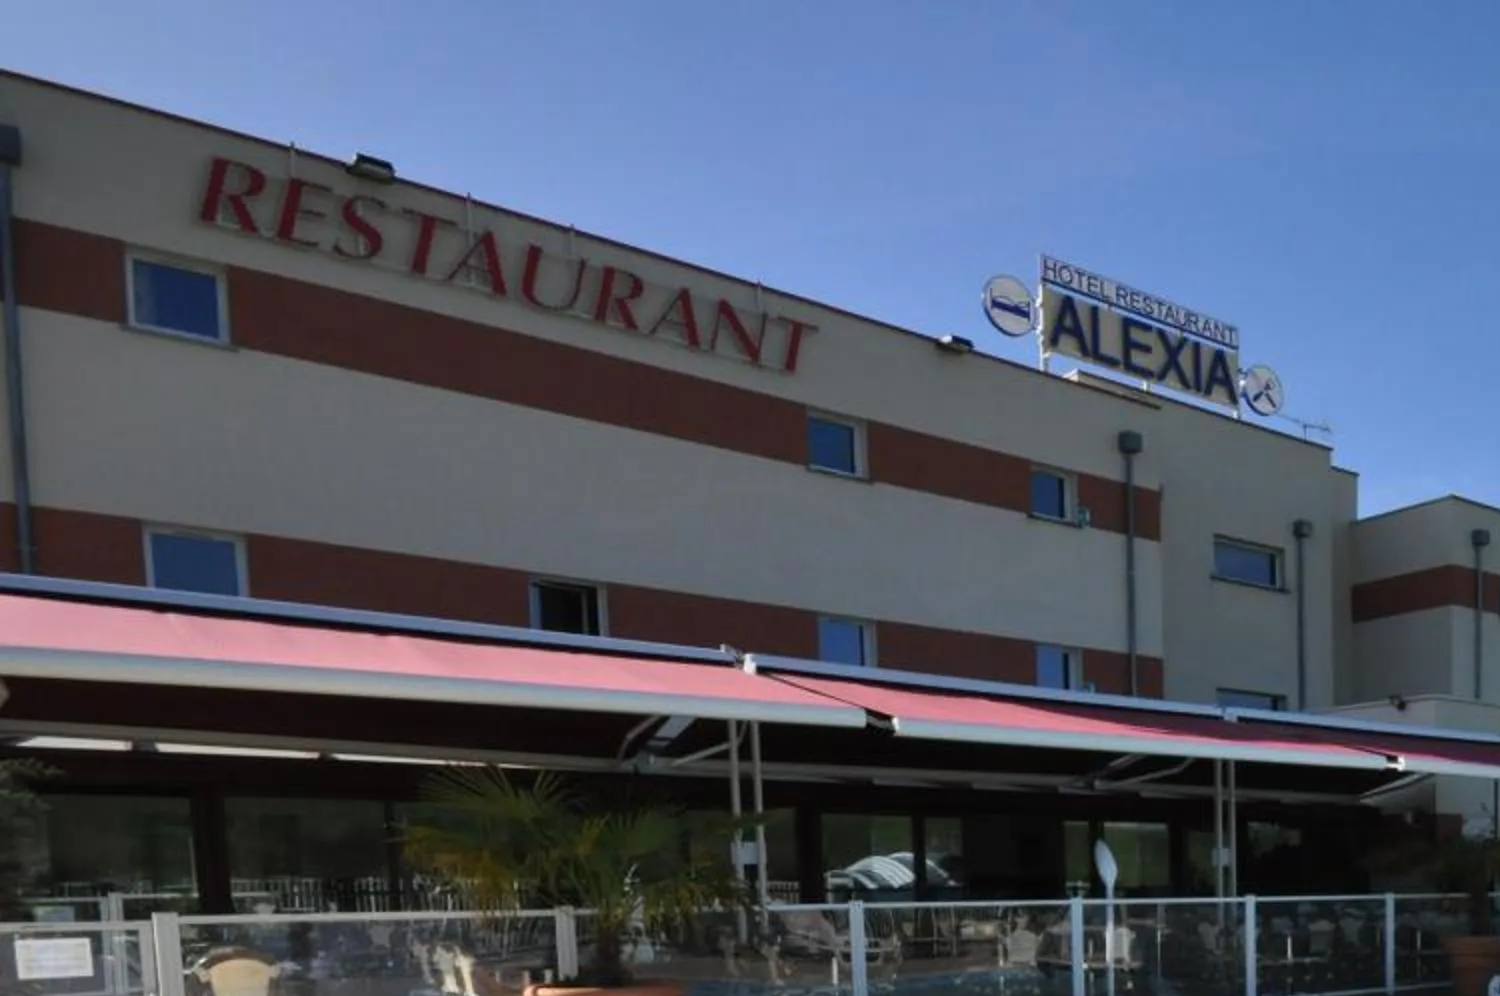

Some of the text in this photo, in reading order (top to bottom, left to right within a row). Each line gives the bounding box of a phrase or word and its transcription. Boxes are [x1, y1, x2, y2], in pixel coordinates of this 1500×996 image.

[200, 156, 818, 373] RESTAURANT
[1042, 259, 1238, 342] HOTEL RESTAURANT
[1050, 295, 1239, 405] ALEXIA
